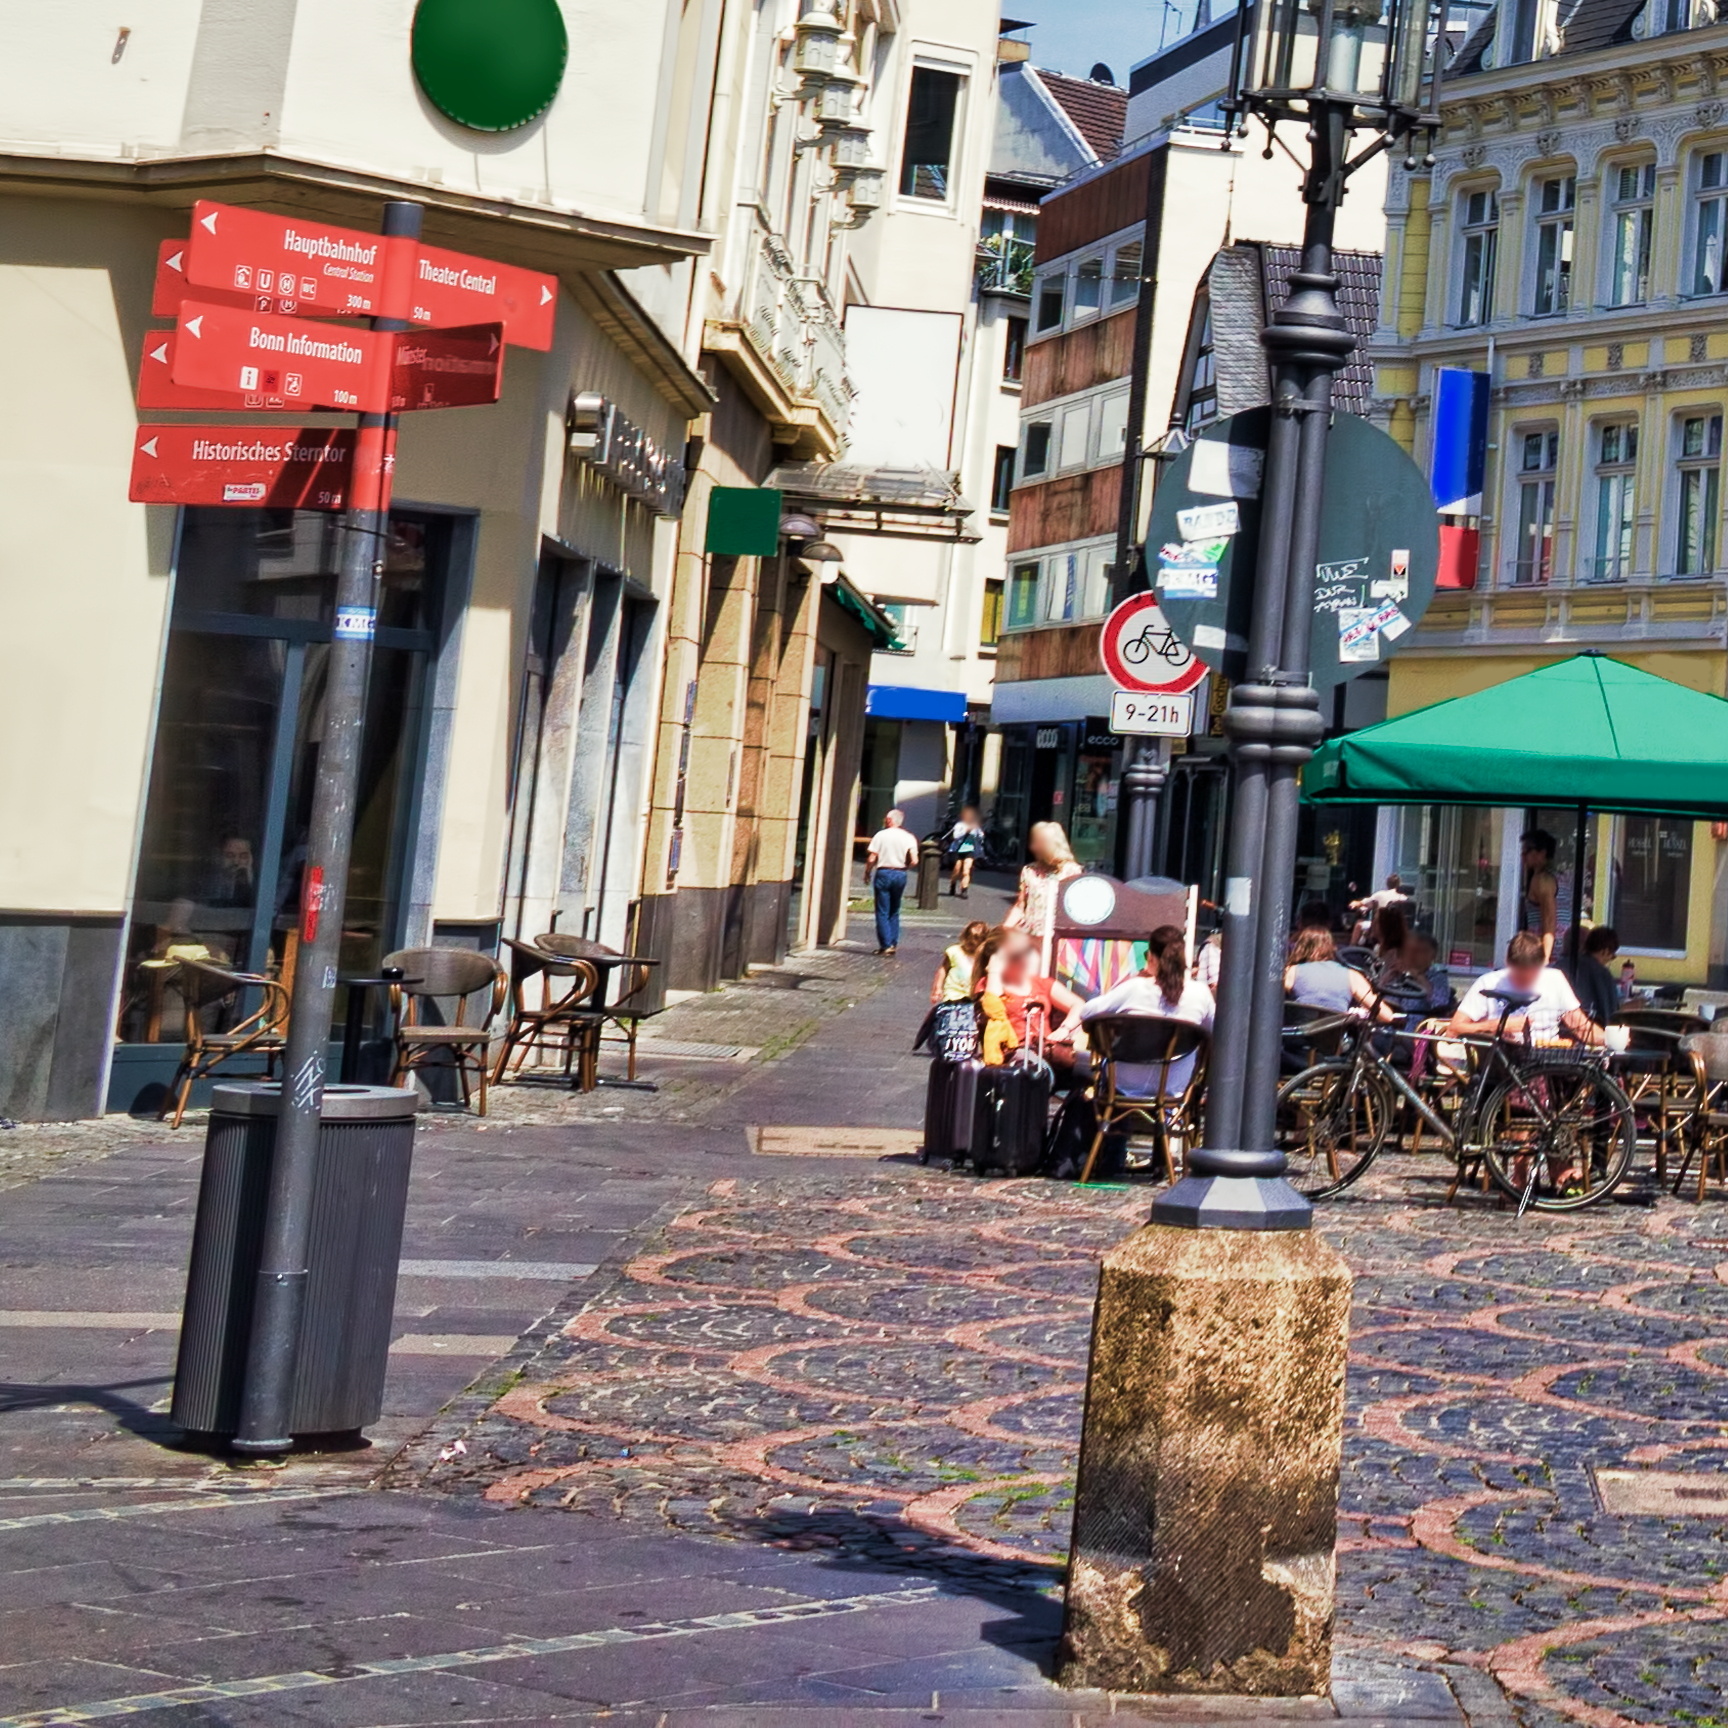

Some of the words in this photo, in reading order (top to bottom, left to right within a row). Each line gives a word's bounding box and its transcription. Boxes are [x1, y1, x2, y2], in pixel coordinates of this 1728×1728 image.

[284, 229, 378, 265] Hauptbahnhof
[323, 263, 350, 278] Central
[349, 267, 374, 283] Station
[419, 259, 459, 286] Theater
[459, 269, 497, 295] Central
[346, 294, 363, 309] 300
[362, 301, 371, 310] m
[413, 306, 424, 319] 50
[423, 312, 431, 321] m
[249, 326, 285, 352] Bonn
[286, 332, 363, 364] Information
[333, 389, 350, 404] 100
[349, 394, 358, 405] m
[192, 440, 280, 462] Historisches
[283, 441, 347, 462] Sterntor
[318, 491, 331, 504] 50
[1125, 703, 1179, 724] 9-21h
[1087, 735, 1119, 746] ecco
